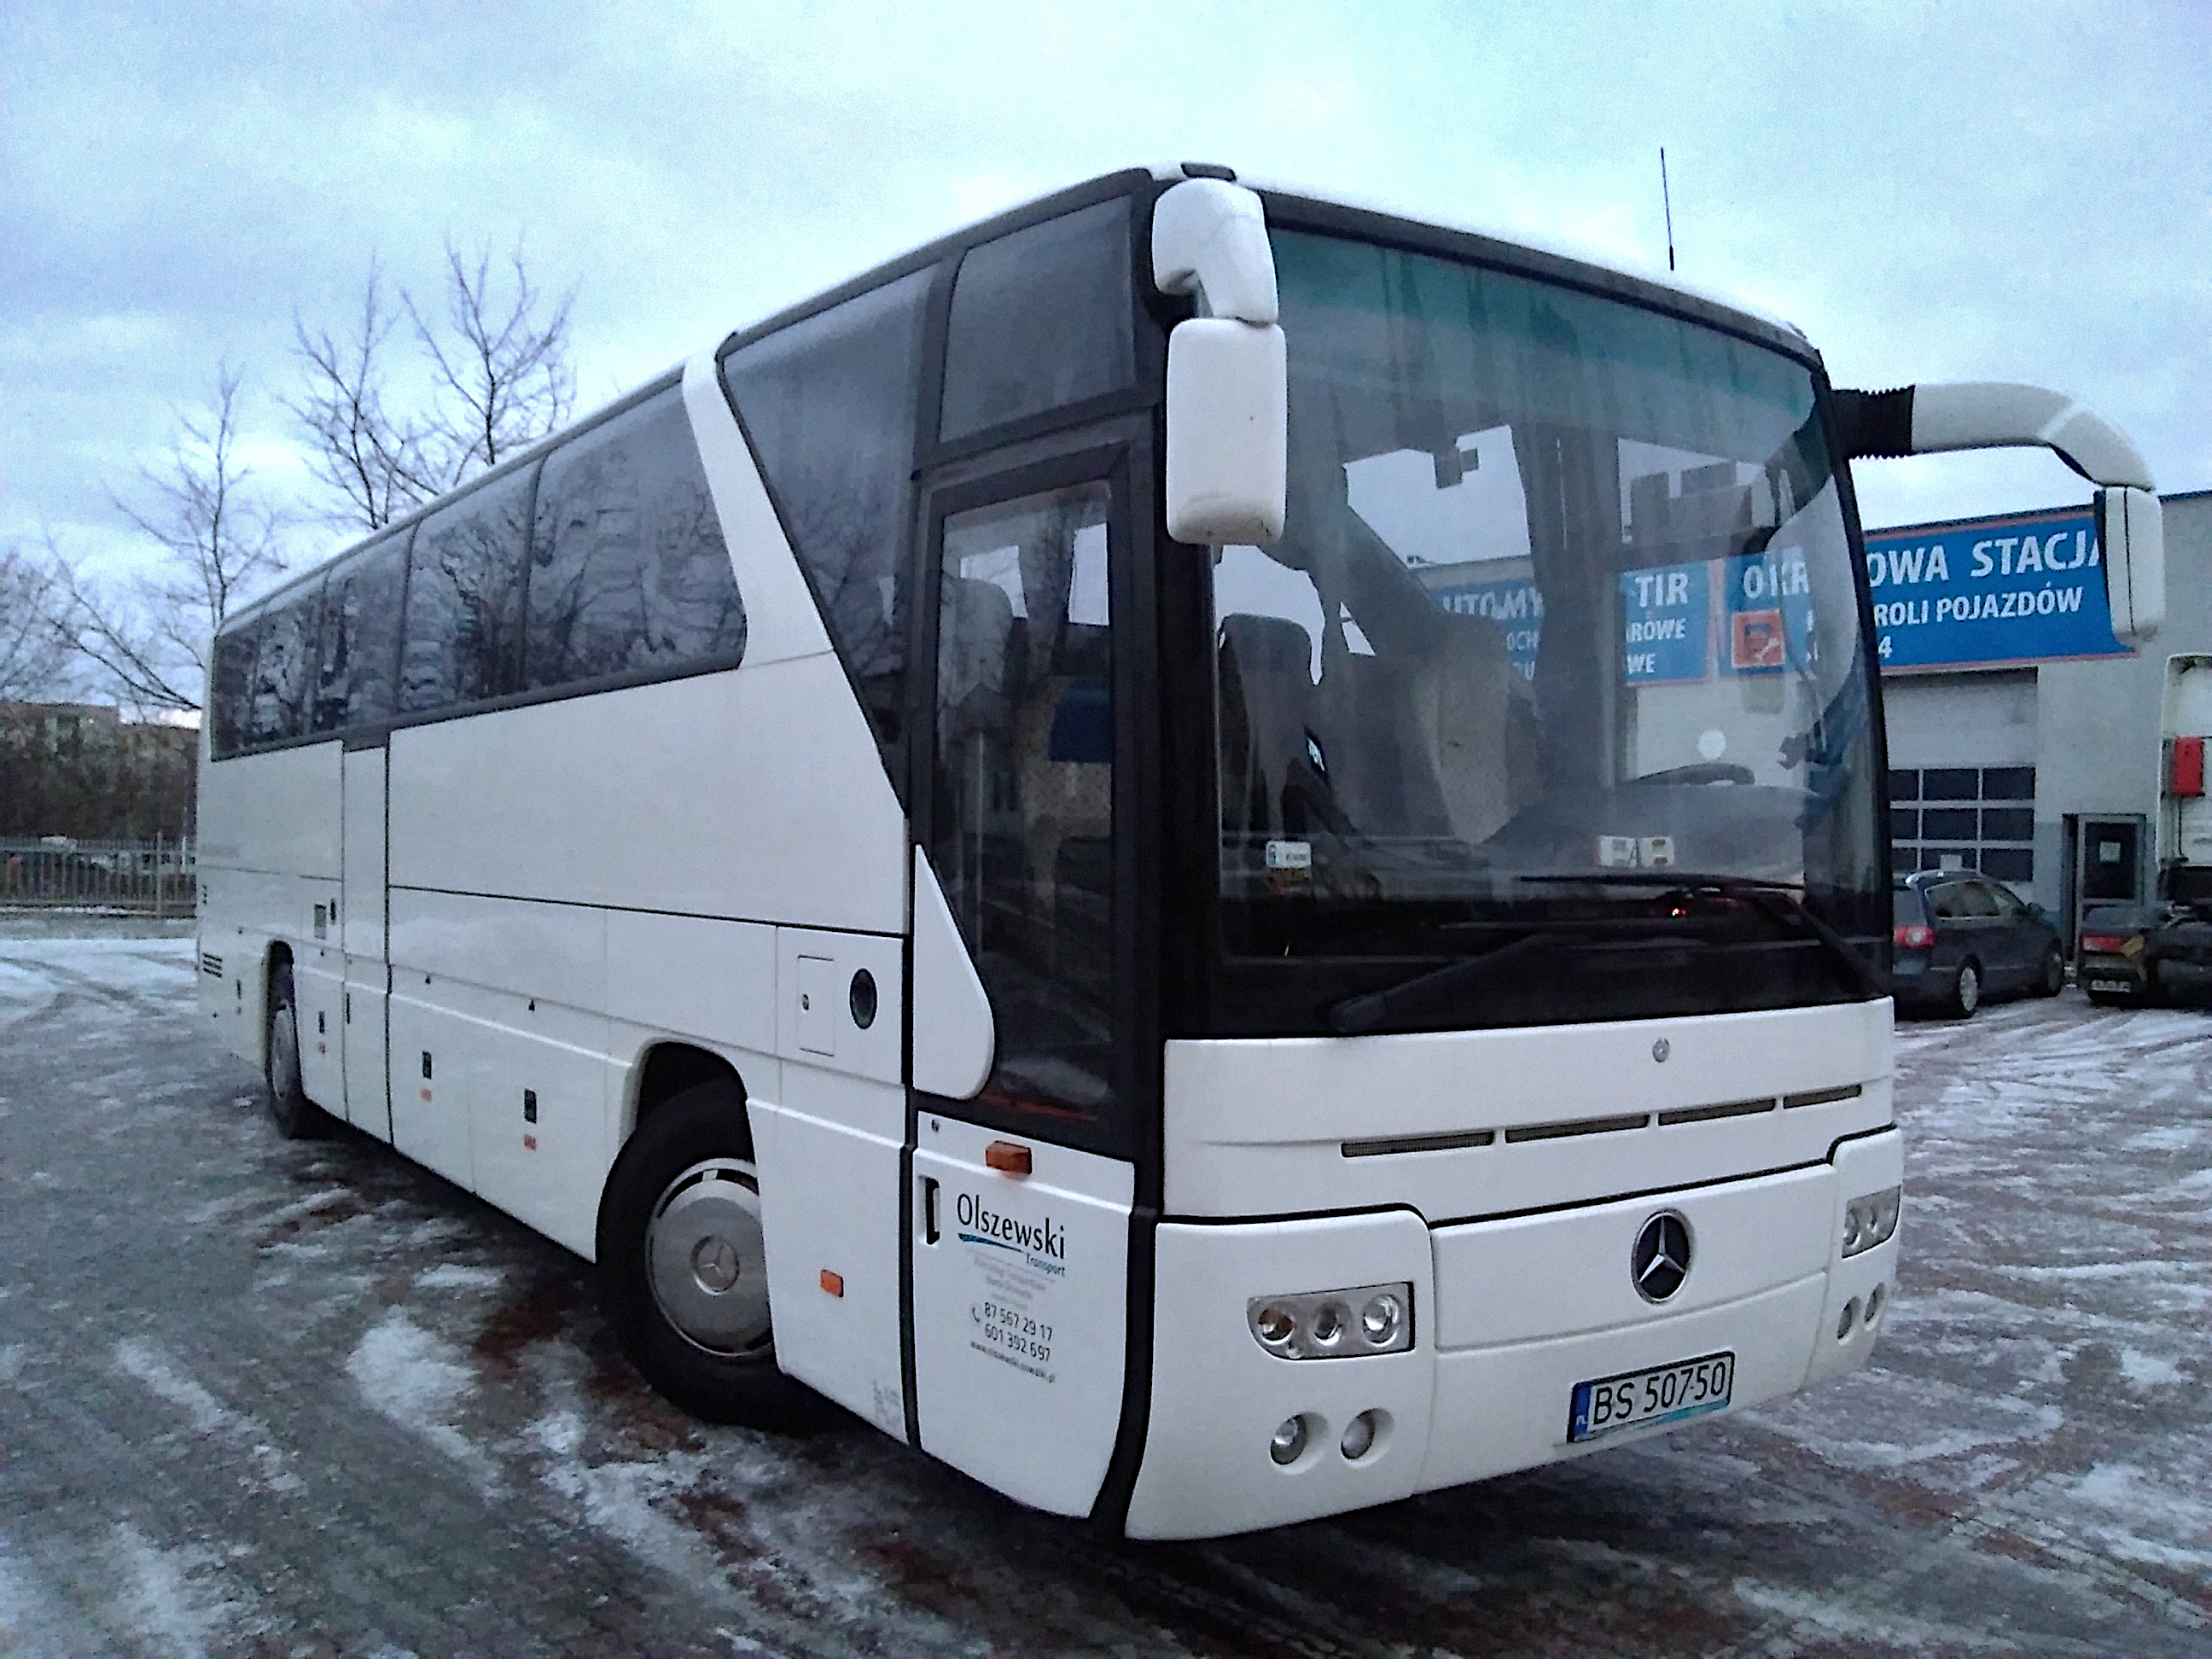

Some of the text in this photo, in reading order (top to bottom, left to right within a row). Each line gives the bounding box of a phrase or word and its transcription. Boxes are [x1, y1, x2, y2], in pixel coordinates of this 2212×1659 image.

[1866, 544, 1949, 587] OWA
[1635, 572, 1688, 608] TIR
[1874, 580, 2084, 626] ROLI POJAZDÓW
[1626, 617, 1686, 642] ROWE
[957, 1193, 1064, 1260] Olszewski
[1026, 1253, 1066, 1277] Transport
[984, 1302, 1053, 1342] 87 567 29 17
[985, 1324, 1004, 1342] 601
[1007, 1331, 1027, 1353] 392
[1030, 1342, 1051, 1362] 697
[1593, 1361, 1726, 1425] BS 50750
